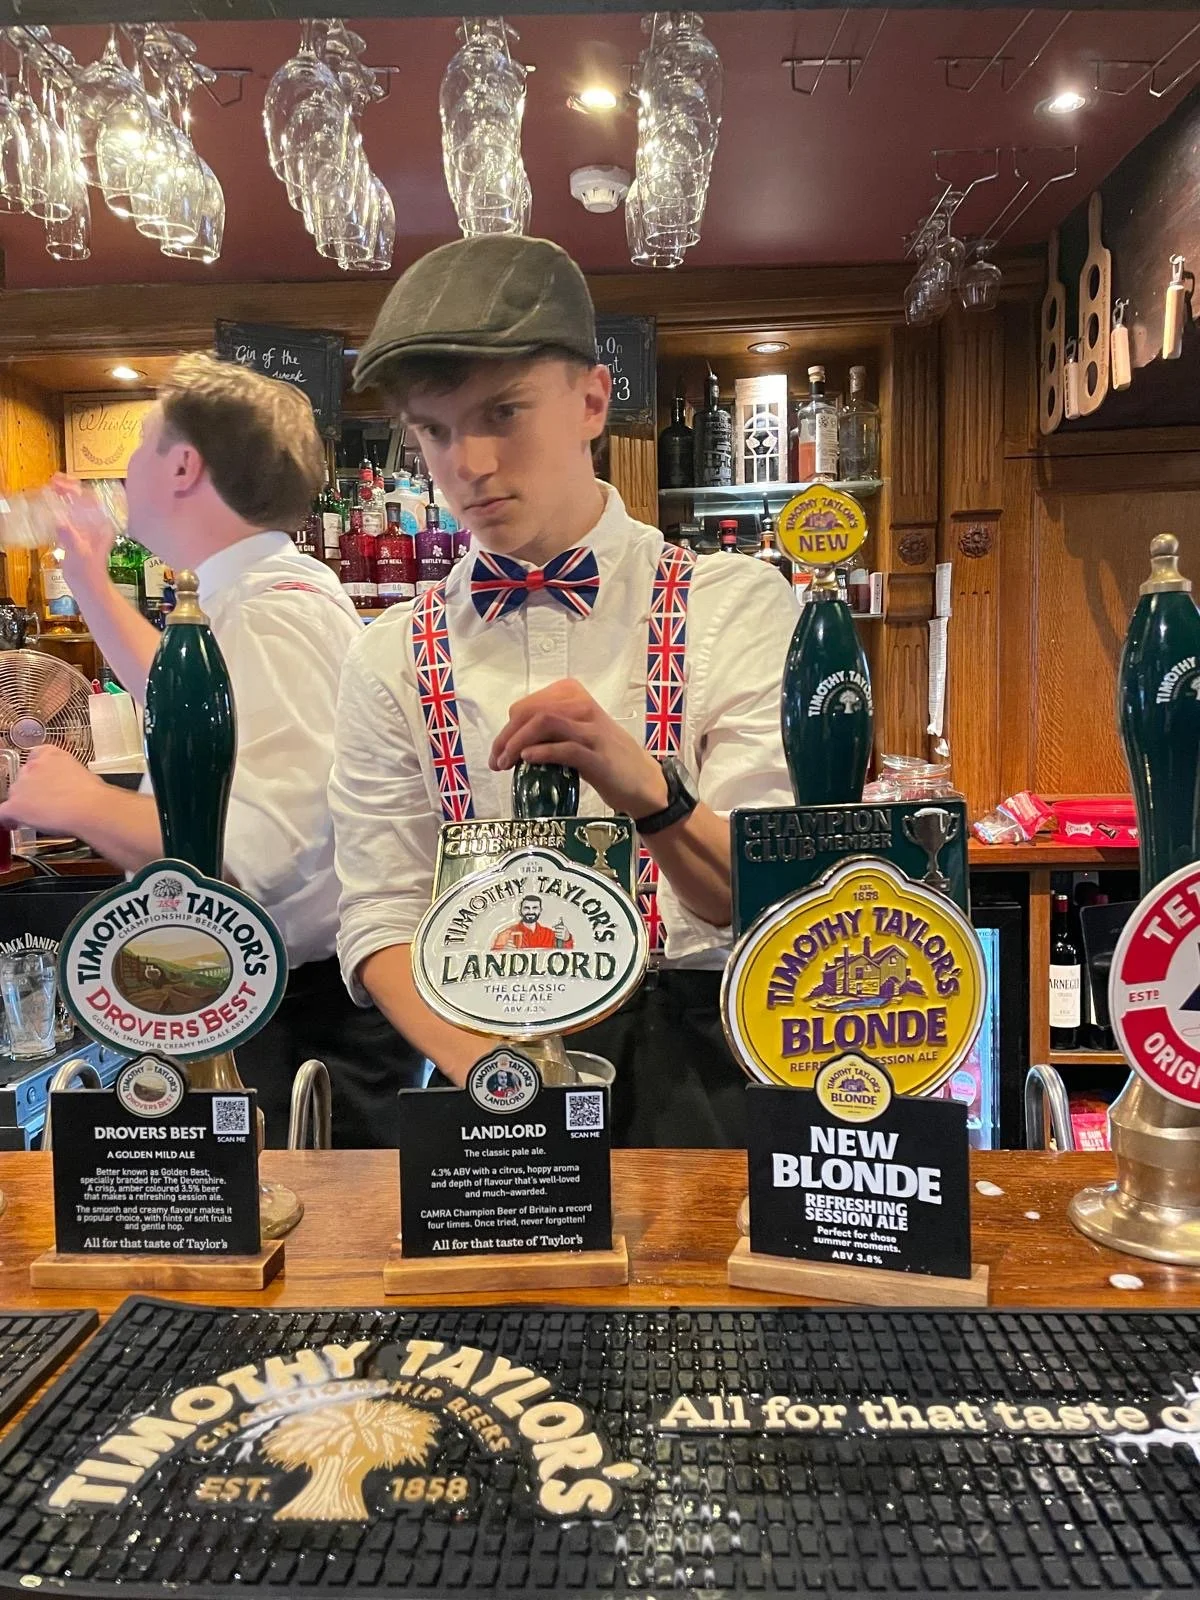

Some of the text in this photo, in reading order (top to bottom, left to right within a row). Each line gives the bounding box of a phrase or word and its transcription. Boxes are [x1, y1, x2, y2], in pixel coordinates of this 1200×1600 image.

[235, 346, 300, 368] Gin of the
[73, 403, 138, 440] Whisky
[799, 534, 849, 552] NEW
[1156, 656, 1196, 704] TIMOTHY
[808, 670, 844, 717] TIMOTHY
[447, 821, 567, 839] CHAMPION
[744, 809, 892, 837] CHAMPION
[445, 837, 565, 856] CLUB MEMBER
[744, 833, 892, 862] CLUB MEMBER
[853, 892, 879, 901] 1858
[444, 876, 616, 946] TIMOTHY TAYLOR'S
[118, 913, 223, 939] CHAMPIONSHIP BEERS
[78, 892, 270, 984] TIMOTHY TAYLOR'S
[766, 907, 963, 1009] TIMOTHY TAYLOR'S
[442, 952, 616, 985] LANDLORD
[484, 984, 566, 994] THE CLASSIC
[496, 993, 553, 1002] PALE ALE
[86, 981, 257, 1040] DROVERS BEST
[781, 1007, 948, 1058] BLONDE
[918, 1051, 938, 1062] ALE
[476, 1061, 533, 1088] TIMOTHY TAYLOR'S
[827, 1068, 881, 1094] TIMOTHY TAYLOR'S
[484, 1092, 525, 1106] LANDLORD
[831, 1092, 877, 1106] BLONDE
[94, 1127, 206, 1140] DROVERS BEST
[462, 1124, 547, 1141] LANDLORD
[810, 1126, 900, 1160] NEW
[464, 1149, 479, 1157] The
[482, 1148, 510, 1157] classic
[512, 1148, 529, 1158] pale
[431, 1168, 451, 1177] 4.3%
[453, 1167, 471, 1176] ABV
[472, 1167, 490, 1175] with
[499, 1166, 525, 1175] citrus,
[527, 1165, 551, 1174] hoppy
[772, 1152, 942, 1205] BLONDE
[80, 1177, 114, 1185] specially
[449, 1180, 472, 1189] depth
[514, 1177, 537, 1185] that's
[539, 1175, 580, 1184] well-loved
[135, 1193, 176, 1202] refreshing
[465, 1188, 548, 1198] and much-awarded.
[420, 1210, 451, 1219] CAMRA
[453, 1208, 495, 1218] Champion
[497, 1207, 516, 1215] Beer
[519, 1206, 527, 1214] of
[529, 1205, 557, 1214] Britain
[565, 1204, 592, 1212] record
[805, 1192, 908, 1217] REFRESHING
[83, 1215, 114, 1223] popular
[116, 1214, 142, 1222] choice,
[447, 1220, 472, 1229] times.
[497, 1218, 518, 1227] tried,
[545, 1216, 585, 1225] forgotten!
[805, 1207, 908, 1231] SESSION ALE
[432, 1234, 583, 1250] All for that taste of Taylor's
[817, 1225, 897, 1243] Perfect for those
[84, 1238, 228, 1250] All for that taste of Taylor's
[813, 1236, 901, 1253] summer moments.
[832, 1250, 883, 1264] ABV 3.8%
[195, 1378, 514, 1453] CHAMPIONSHIP BEERS
[659, 1396, 1150, 1433] All for that taste
[48, 1339, 644, 1516] TIMOTHY TAYLOR'S
[199, 1477, 468, 1501] EST. 1858
